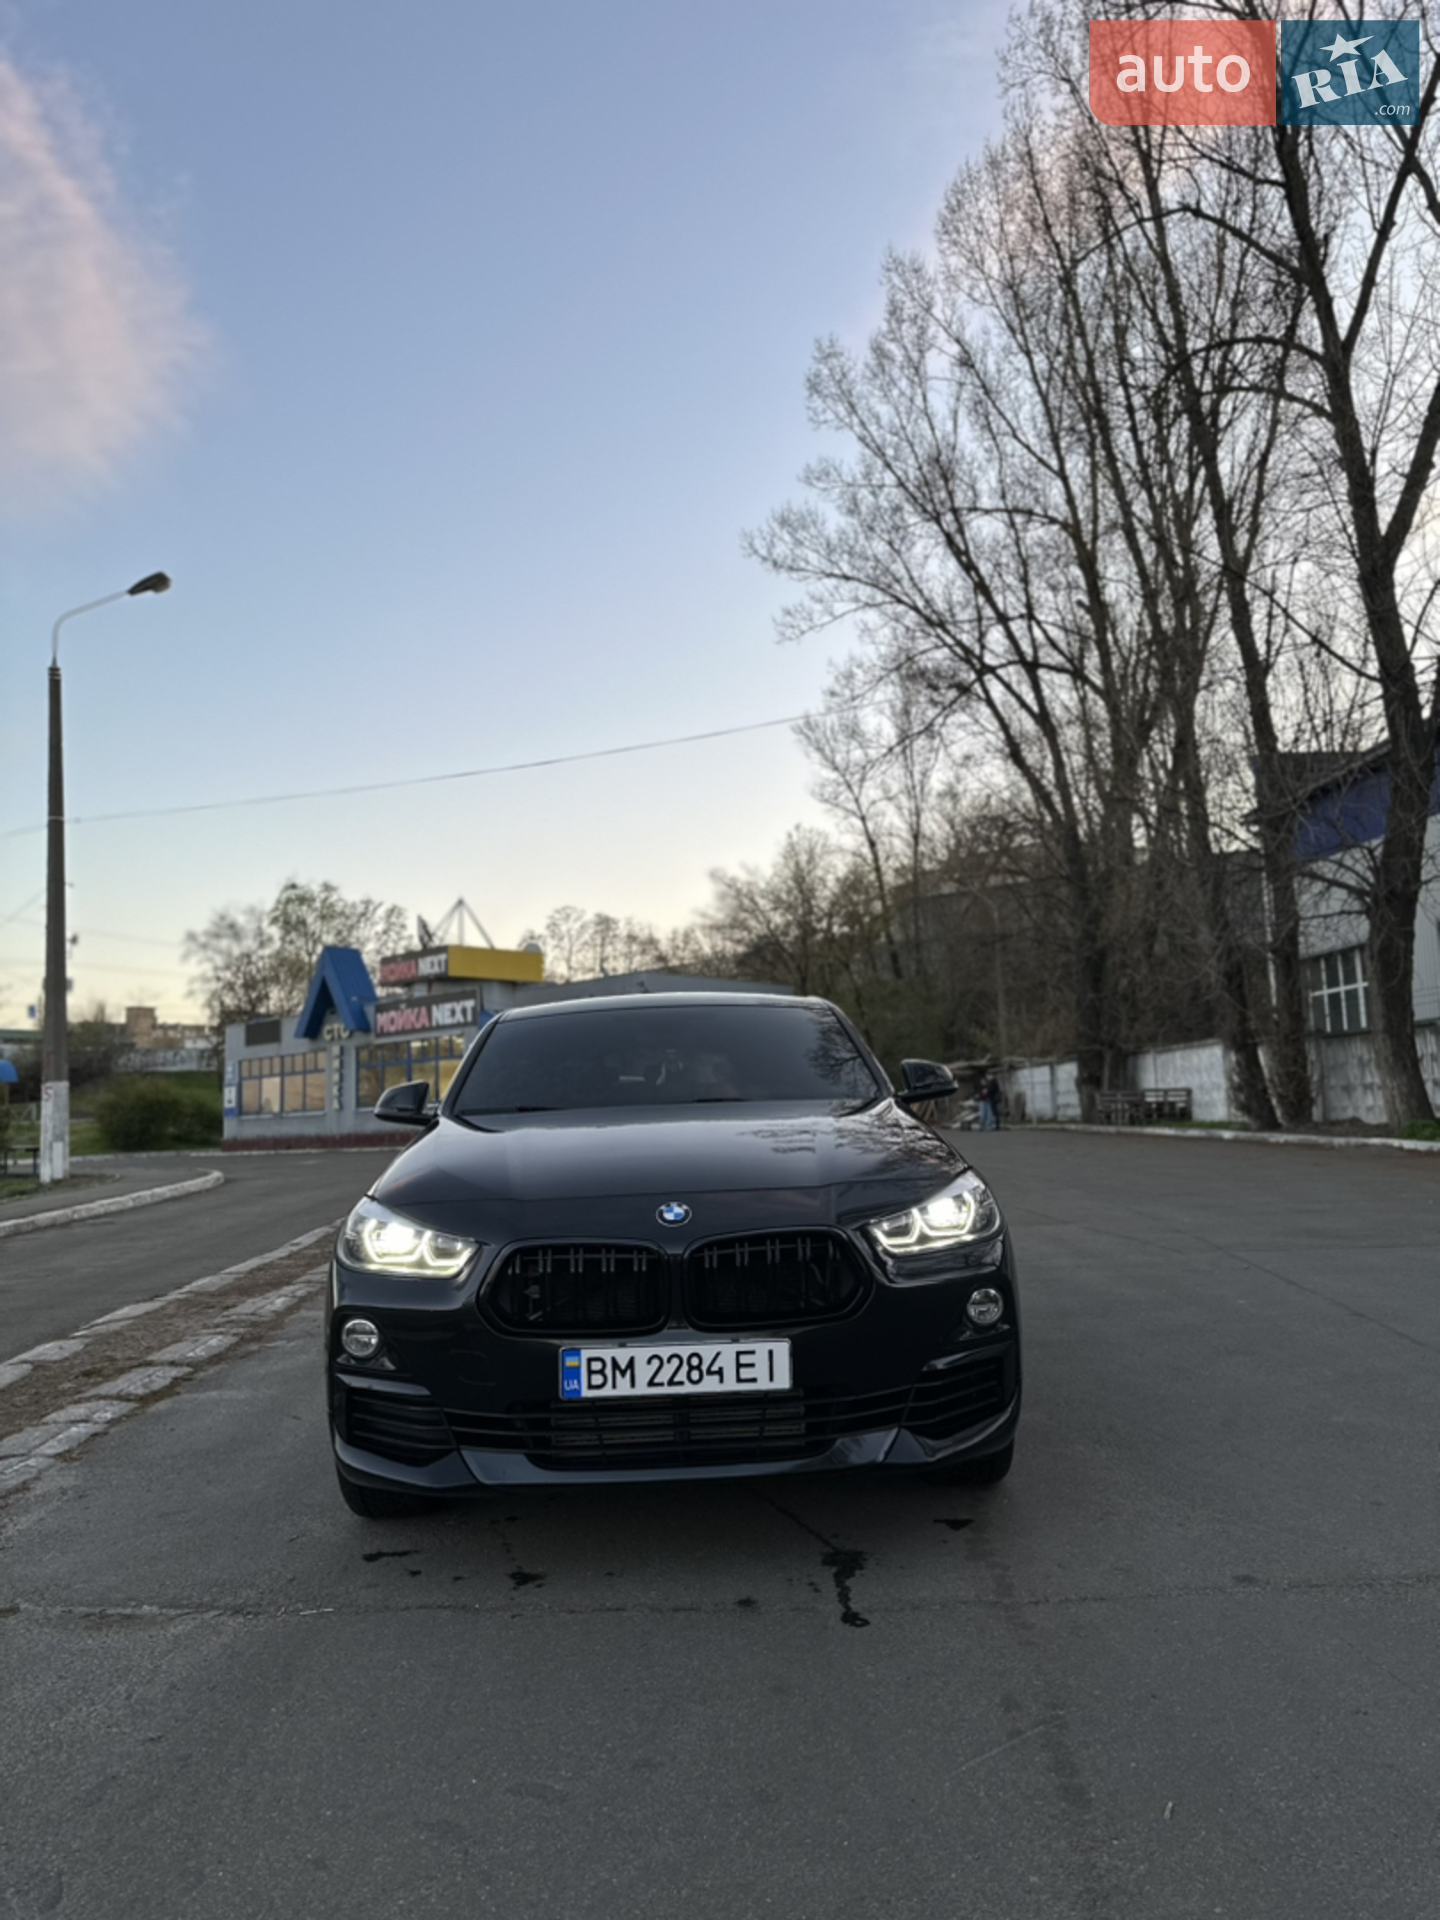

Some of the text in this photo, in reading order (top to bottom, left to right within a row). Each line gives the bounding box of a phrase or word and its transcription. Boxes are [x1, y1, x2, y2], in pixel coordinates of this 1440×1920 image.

[417, 952, 447, 977] NEXT
[376, 998, 476, 1035] МОЙКА NEXT
[564, 1379, 580, 1391] UA
[586, 1356, 636, 1390] BM
[646, 1351, 725, 1388] 2284
